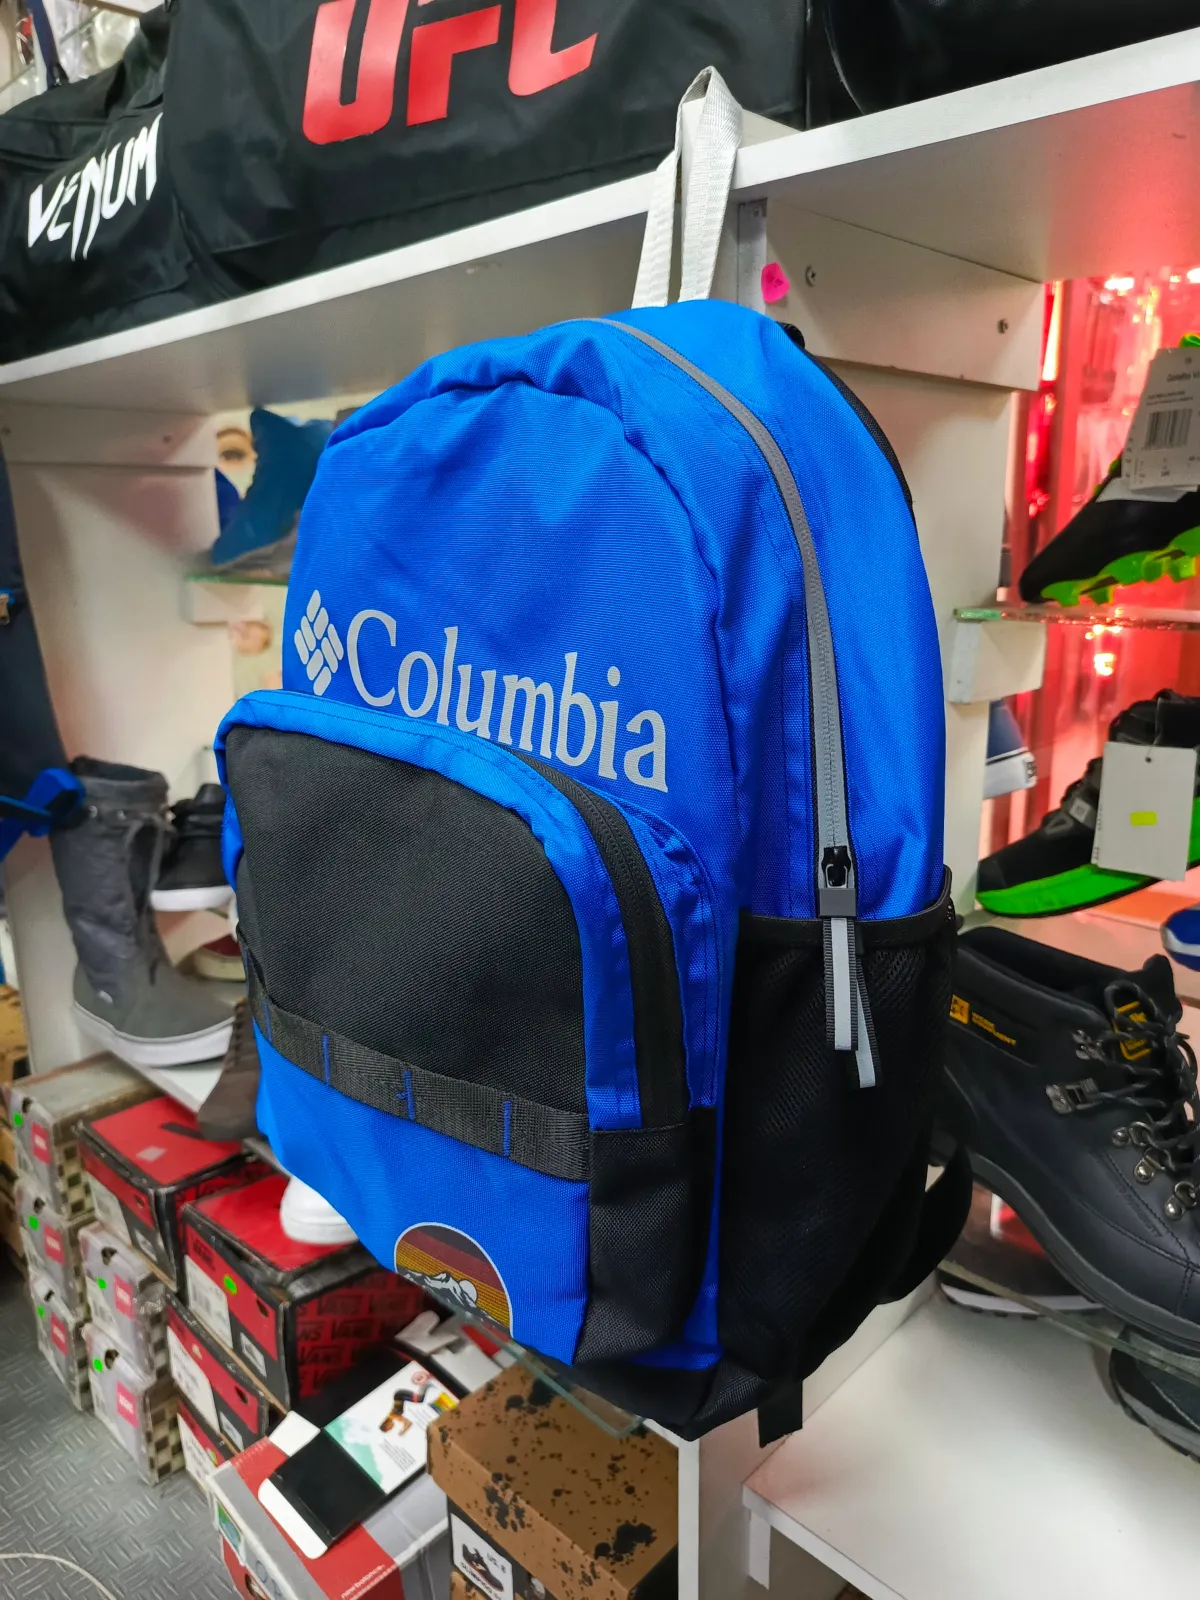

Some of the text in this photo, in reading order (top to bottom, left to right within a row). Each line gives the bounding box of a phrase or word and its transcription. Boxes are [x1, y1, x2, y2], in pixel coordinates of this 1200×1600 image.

[302, 0, 599, 145] UFC
[27, 112, 165, 261] VENUM
[346, 609, 668, 793] Columbia
